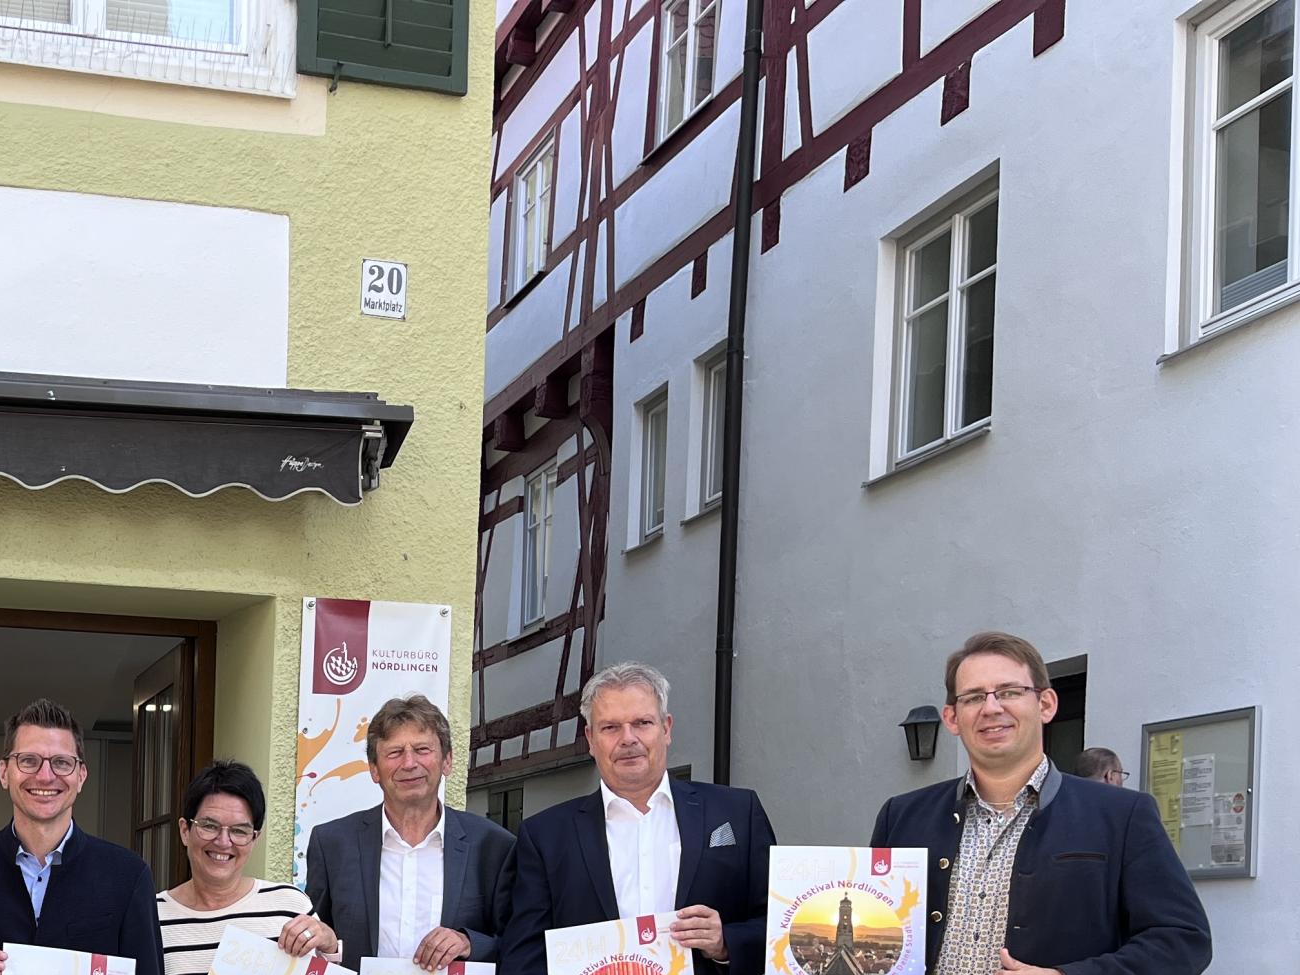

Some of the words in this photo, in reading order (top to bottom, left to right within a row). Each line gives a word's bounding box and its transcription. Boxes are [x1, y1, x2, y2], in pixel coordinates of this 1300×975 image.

[368, 265, 402, 295] 20
[364, 297, 403, 313] Marktplatz
[372, 649, 438, 660] KULTURBÜRO
[372, 660, 438, 672] NÖRDLINGEN
[780, 881, 834, 929] Kulturfestival
[838, 880, 895, 907] Nördlingen
[610, 953, 664, 973] Nördlingen
